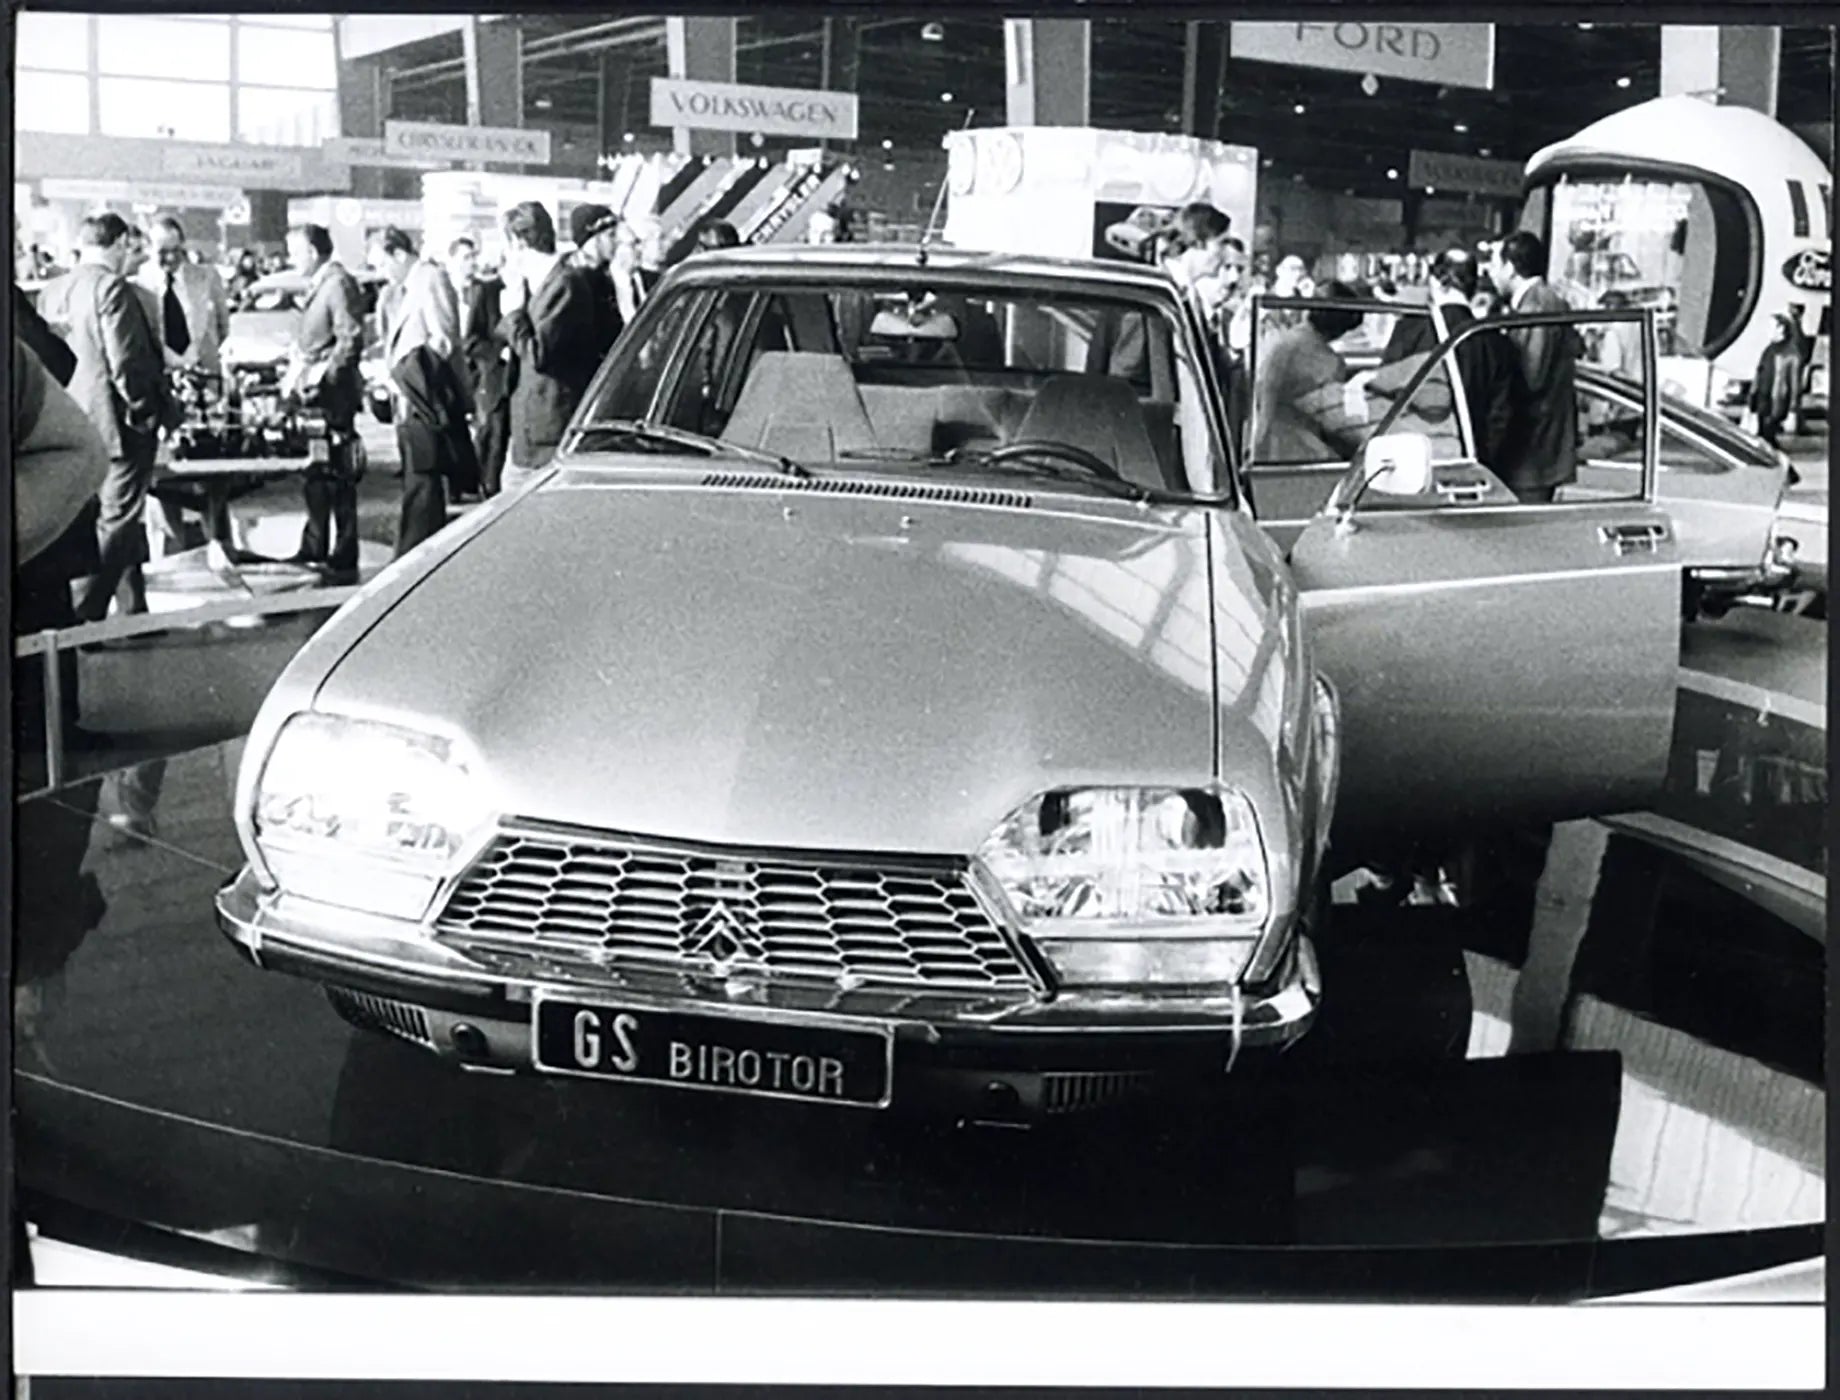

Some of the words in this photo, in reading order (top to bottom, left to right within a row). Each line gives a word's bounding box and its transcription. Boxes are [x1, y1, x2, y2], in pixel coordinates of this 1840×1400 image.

[1297, 22, 1440, 60] FORD
[670, 91, 836, 123] VOLKSWAGEN
[573, 1009, 638, 1071] GS
[669, 1042, 845, 1095] BIROTOR
